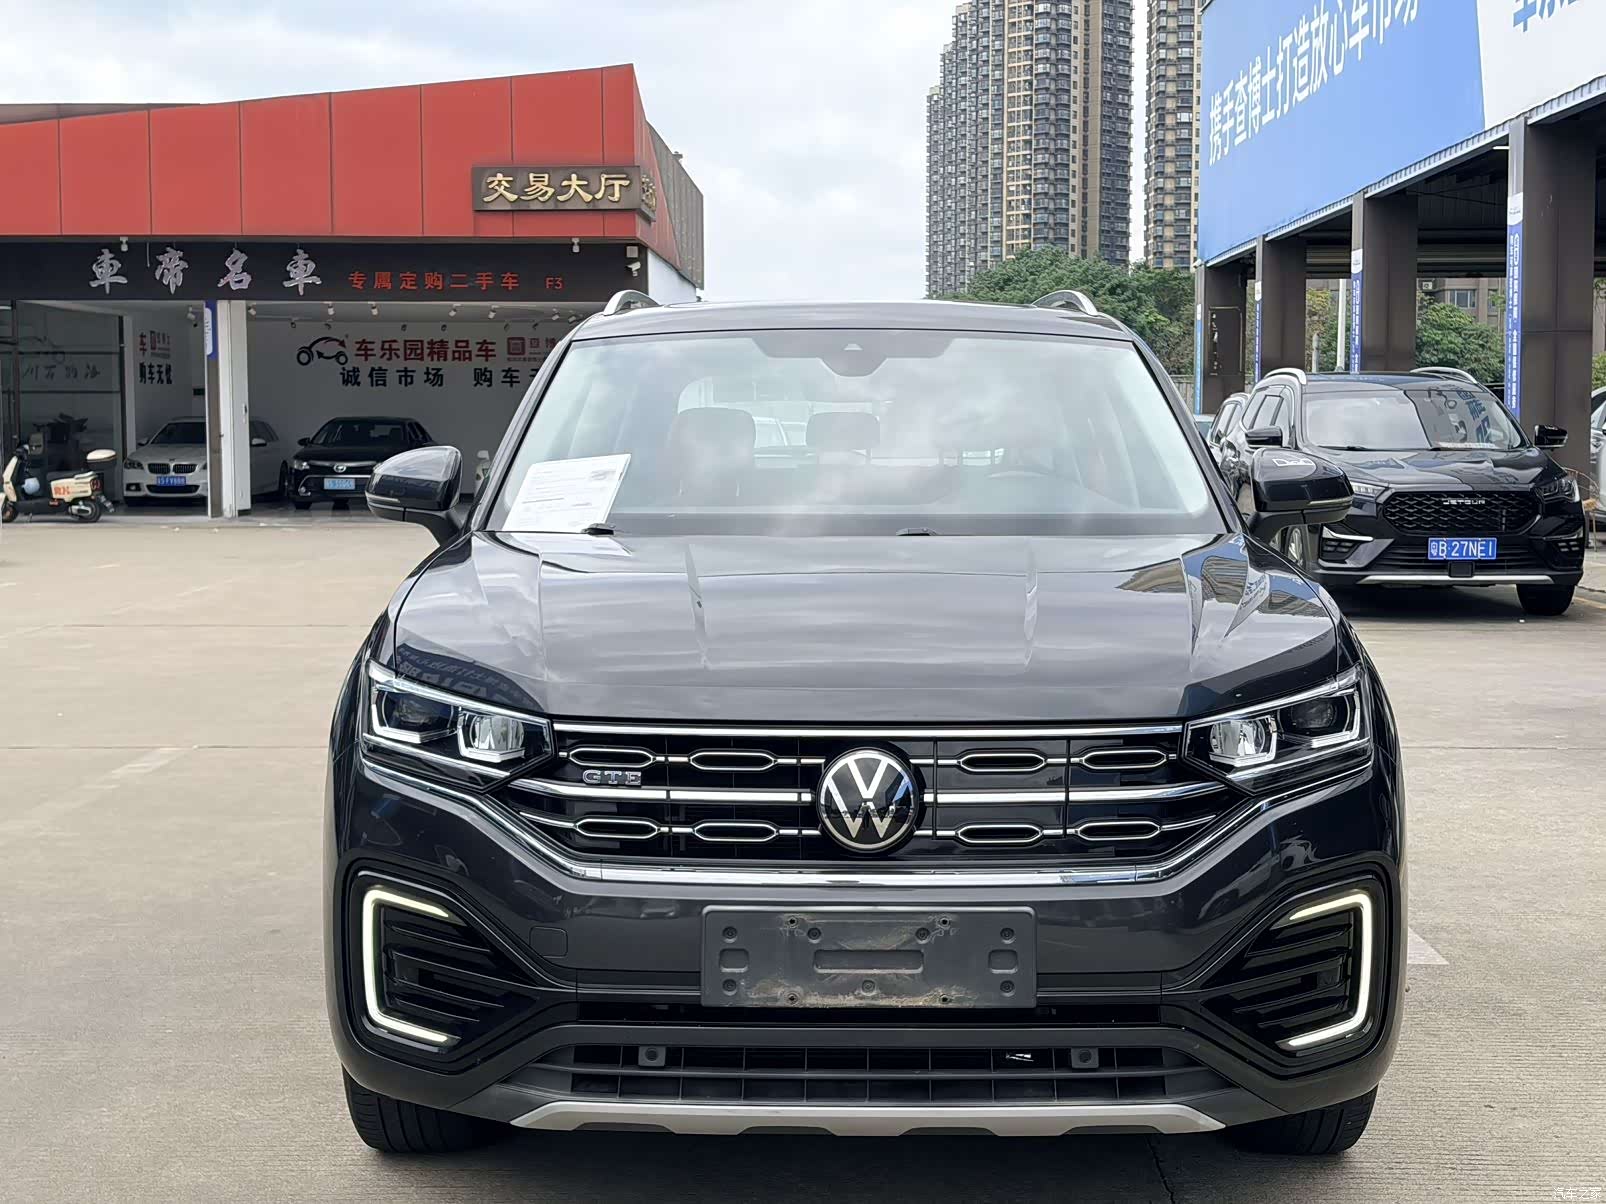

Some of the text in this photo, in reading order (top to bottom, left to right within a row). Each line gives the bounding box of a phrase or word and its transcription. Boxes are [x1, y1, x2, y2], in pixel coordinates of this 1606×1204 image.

[1209, 0, 1418, 166] 携手查博士打造放心车
[483, 172, 630, 203] 交易大厅
[348, 271, 564, 290] 专属定购二手车 F3
[354, 338, 497, 362] 车乐园精品车
[340, 367, 444, 387] 诚信市场
[582, 769, 642, 786] GTE
